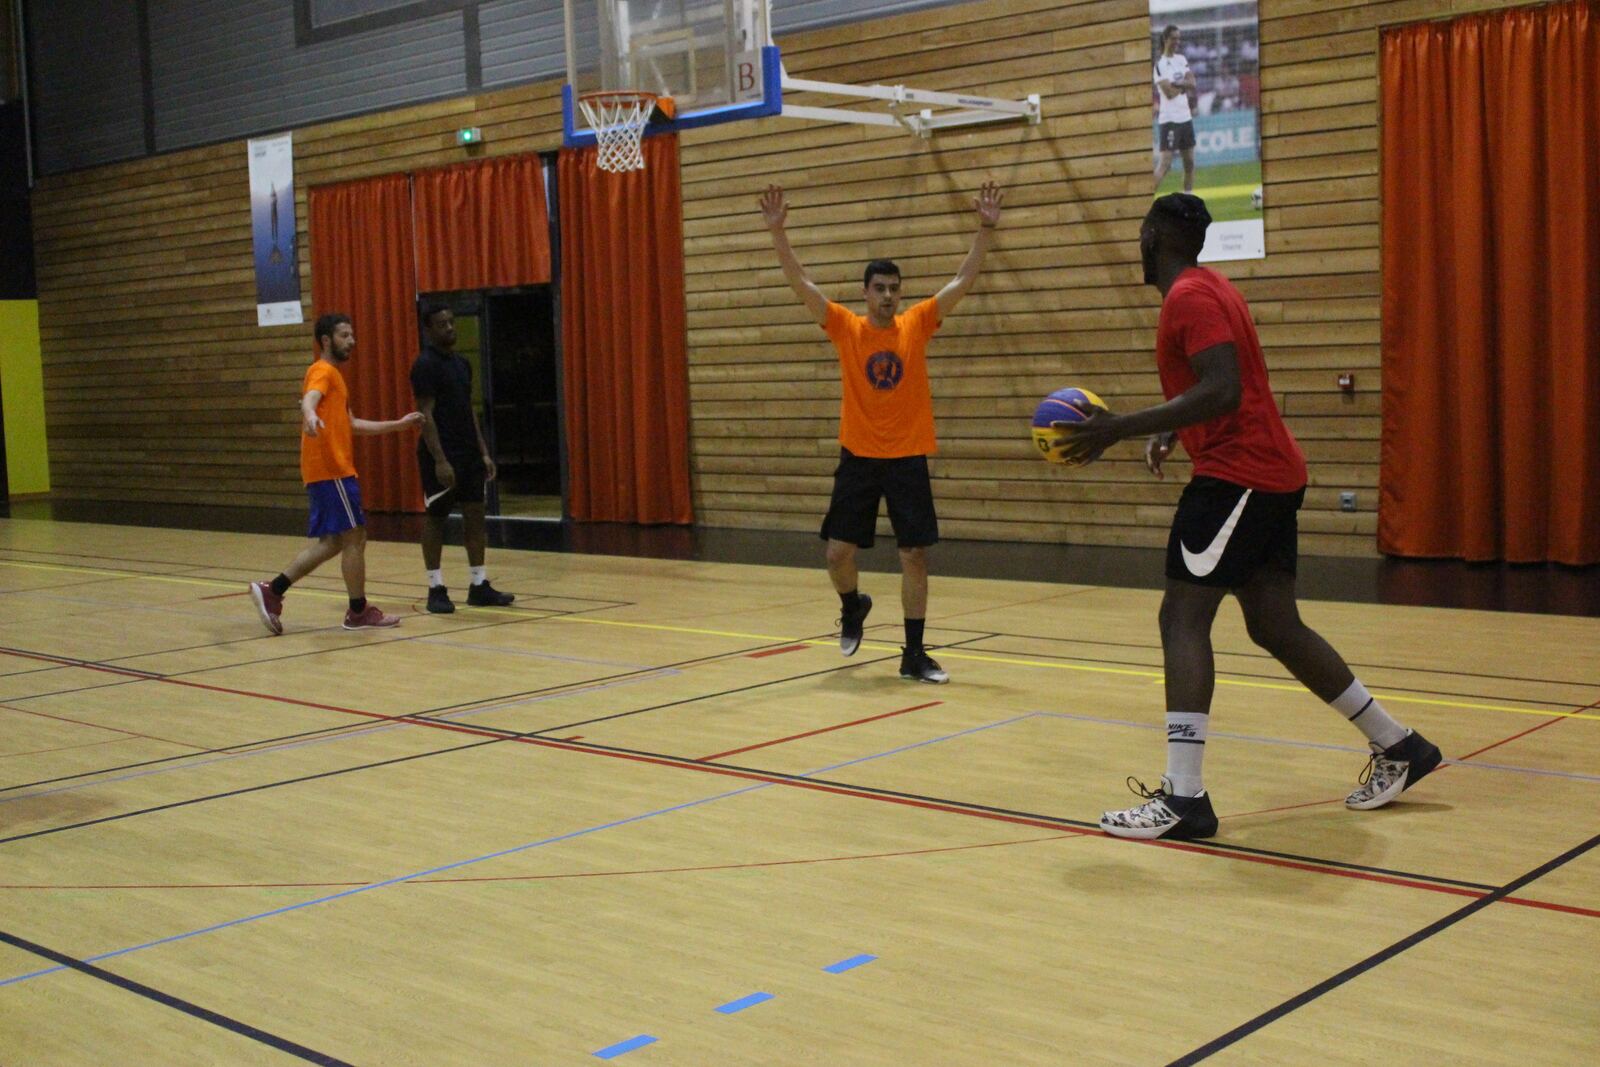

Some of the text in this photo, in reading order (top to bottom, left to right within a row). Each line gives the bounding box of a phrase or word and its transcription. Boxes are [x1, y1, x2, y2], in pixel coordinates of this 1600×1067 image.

[737, 62, 755, 91] B
[1196, 127, 1254, 153] COLE
[1168, 723, 1194, 731] NIKE
